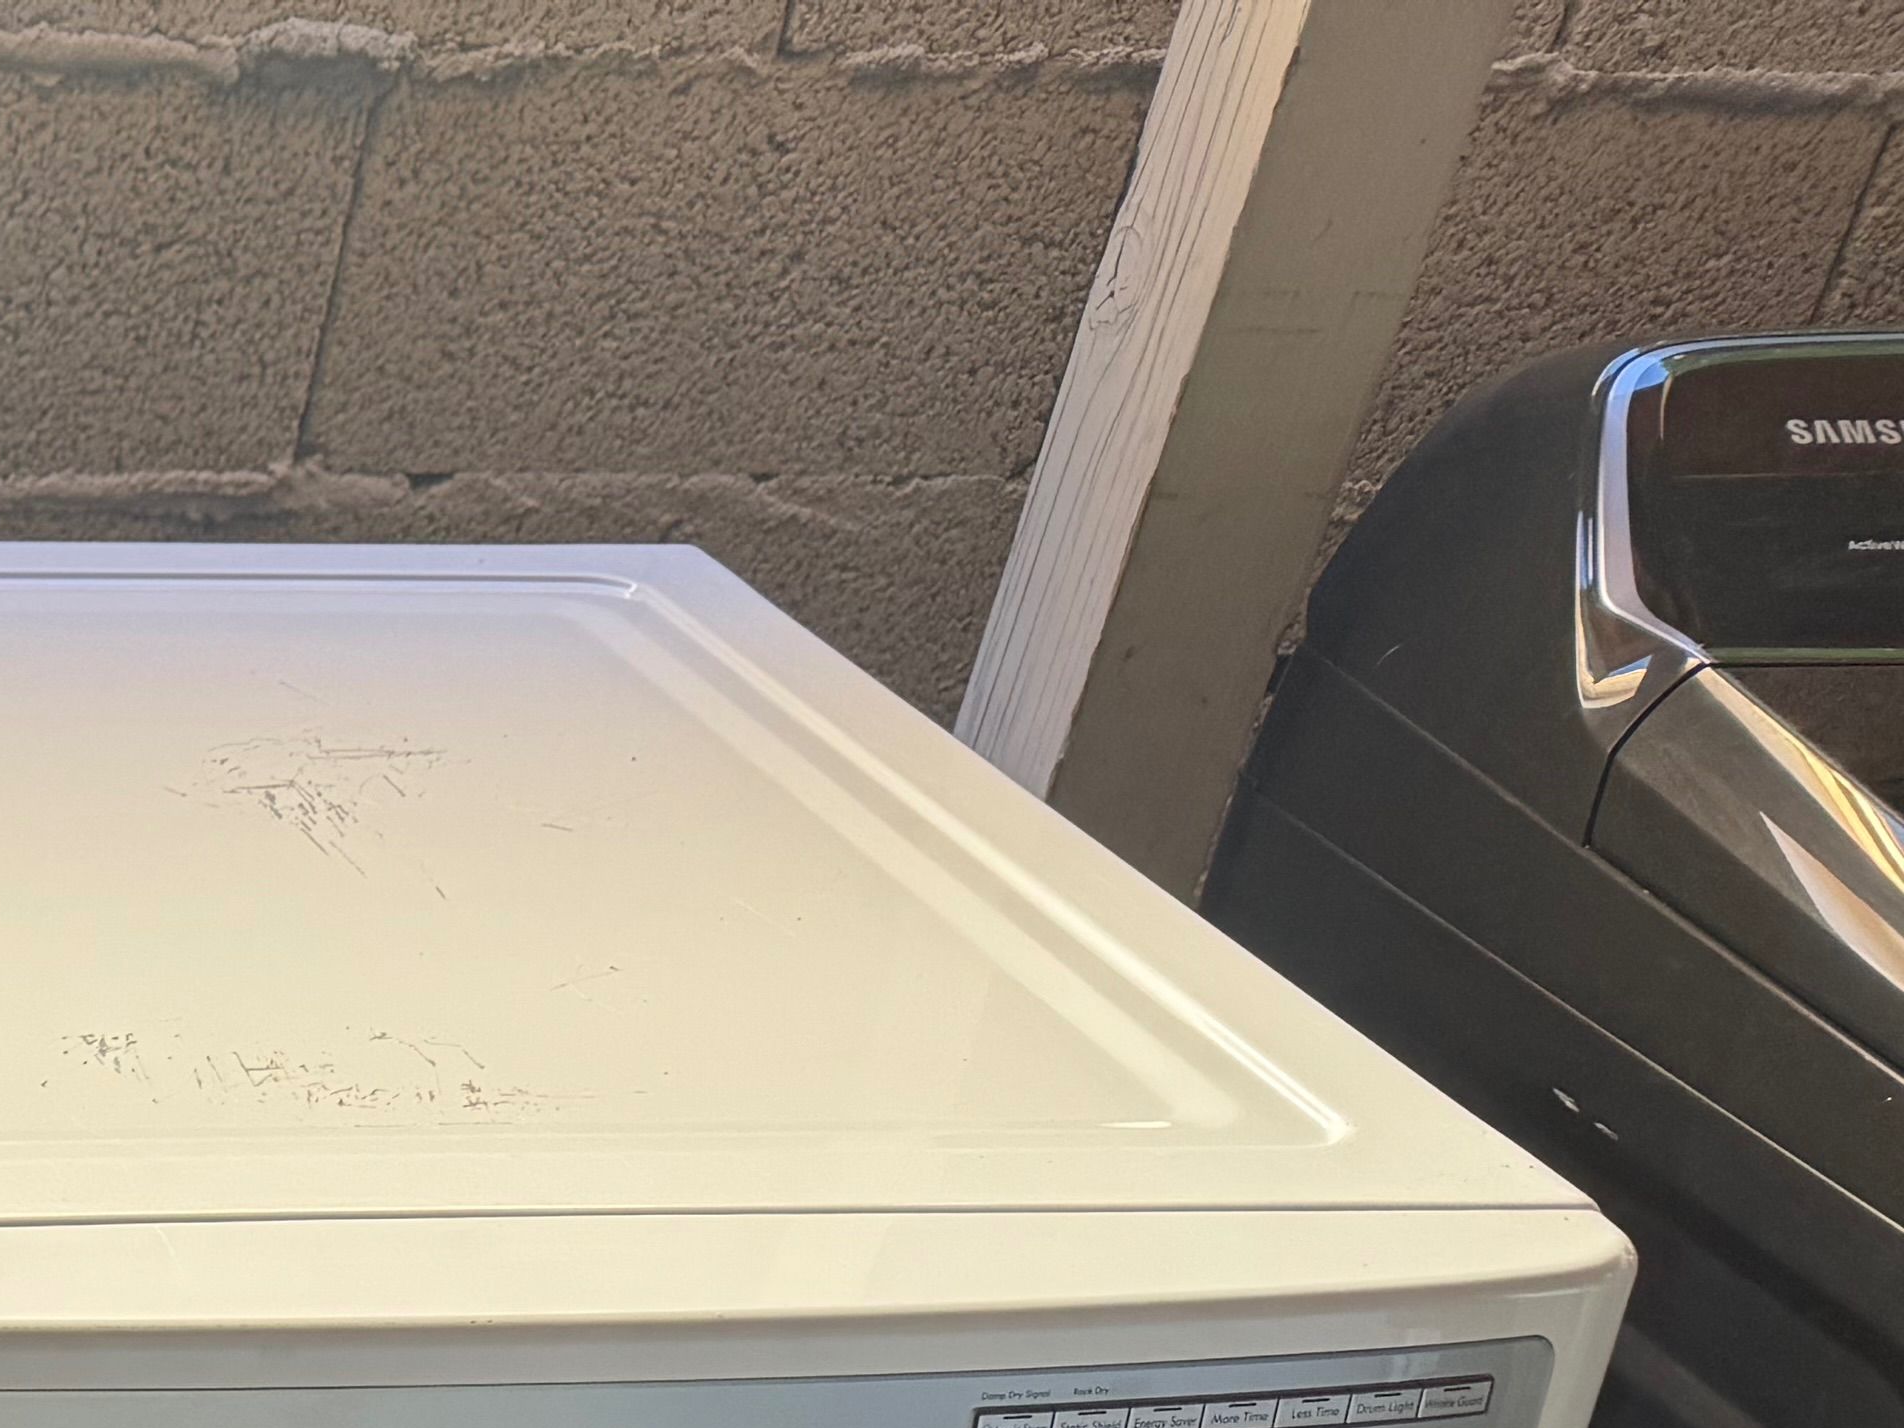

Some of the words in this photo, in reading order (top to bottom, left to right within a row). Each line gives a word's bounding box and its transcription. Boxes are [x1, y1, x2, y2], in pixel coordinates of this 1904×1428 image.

[1785, 419, 1904, 444] SAMS
[1389, 1401, 1414, 1412] Light
[1211, 1414, 1240, 1424] More
[1244, 1411, 1268, 1421] Time
[1292, 1409, 1313, 1419] Less
[1316, 1407, 1339, 1417] Time
[1170, 1417, 1197, 1427] Saver
